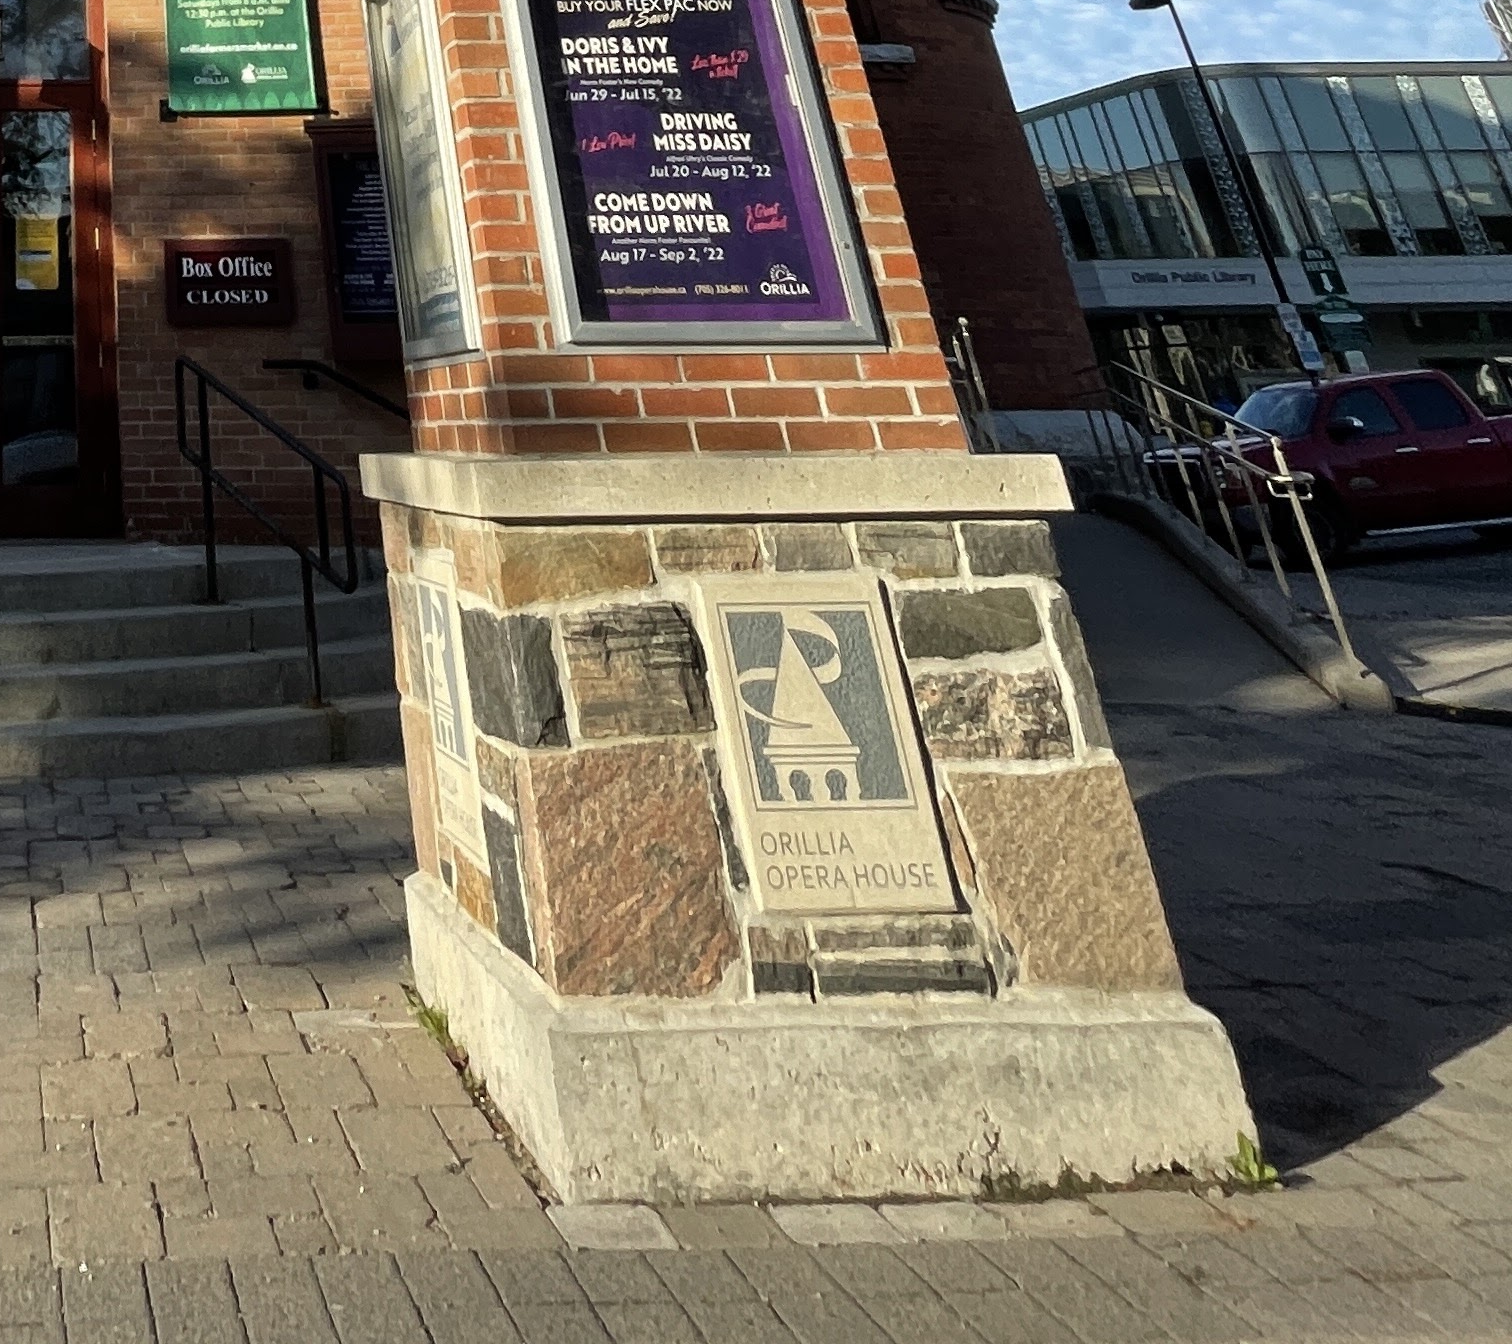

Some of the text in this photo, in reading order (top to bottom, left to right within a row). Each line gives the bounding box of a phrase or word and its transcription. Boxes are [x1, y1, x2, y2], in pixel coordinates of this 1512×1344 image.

[210, 9, 229, 18] p.m.
[230, 8, 240, 16] at
[241, 7, 255, 16] the
[256, 6, 285, 16] Orillia
[556, 0, 581, 13] BUY
[584, 0, 625, 13] YOUR
[697, 0, 733, 12] NOW
[205, 17, 264, 28] Public Library
[607, 8, 677, 29] and Save!
[561, 37, 669, 55] DORIS & IVY
[562, 56, 679, 75] IN THE HOME
[565, 89, 588, 102] Jun
[590, 89, 608, 102] 29
[620, 88, 640, 102] Jul
[642, 88, 659, 103] 15,
[660, 112, 738, 131] DRIVING
[653, 133, 752, 152] MISS DAISY
[649, 165, 670, 178] Jul
[672, 165, 690, 178] 20
[701, 165, 729, 180] Aug
[731, 164, 749, 179] 12,
[594, 193, 714, 212] COME DOWN
[588, 216, 643, 234] FROM
[644, 215, 670, 234] UP
[673, 215, 731, 233] RIVER
[600, 248, 630, 264] Aug
[632, 248, 647, 261] 17
[658, 248, 685, 263] Sep
[687, 247, 701, 263] 2,
[181, 255, 273, 278] Box Office
[1170, 271, 1210, 283] Public
[1211, 271, 1256, 285] Library
[186, 288, 269, 305] CLOSED
[760, 281, 811, 296] ORILLIA
[760, 830, 854, 857] ORILLIA
[766, 862, 939, 891] OPERA HOUSE
